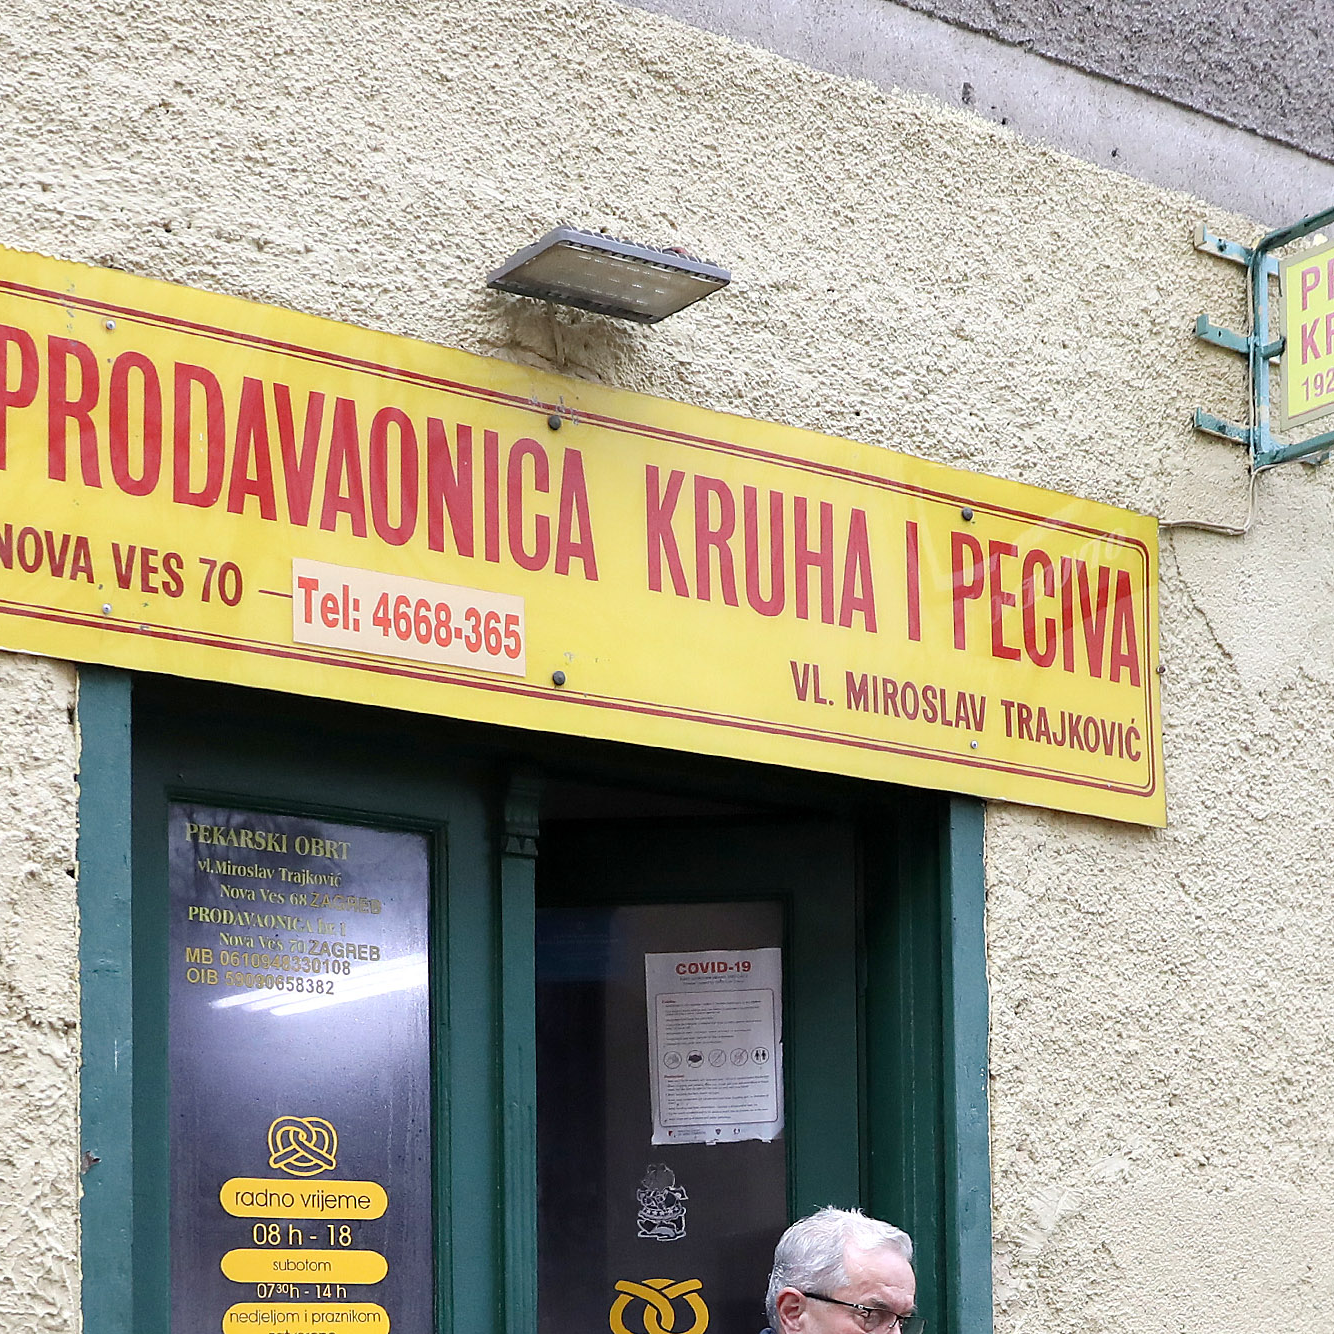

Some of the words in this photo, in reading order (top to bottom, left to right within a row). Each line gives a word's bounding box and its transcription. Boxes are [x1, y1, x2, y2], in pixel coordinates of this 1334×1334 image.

[110, 541, 186, 600] VES
[198, 556, 244, 608] 70
[644, 463, 879, 635] KRUHA
[905, 520, 922, 643] I
[950, 529, 1142, 689] PECIVA
[297, 575, 362, 634] Tel:
[371, 591, 523, 661] 4668-365
[789, 659, 835, 707] VL.
[845, 669, 988, 734] MIROSLAV
[1000, 698, 1143, 764] TRAJKOVIĆ
[184, 821, 288, 855] PEKARSKI
[294, 834, 352, 861] OBRT
[278, 867, 342, 888] Trajković
[219, 882, 255, 902] Nova
[259, 887, 285, 905] Ves
[289, 892, 307, 906] 68
[309, 892, 381, 914] ZAGREB
[187, 905, 313, 933] PRODAVAONICA
[185, 947, 213, 965] MB
[218, 931, 254, 949] Nova
[258, 935, 284, 952] Ves
[307, 939, 381, 961] ZAGREB
[185, 967, 218, 984] OIB
[675, 959, 752, 975] COVID-19
[234, 1188, 294, 1207] radno
[299, 1188, 371, 1211] vrijeme
[251, 1222, 281, 1245] 08
[287, 1223, 303, 1245] h
[326, 1223, 352, 1247] 18
[272, 1257, 332, 1272] subotom
[315, 1283, 332, 1298] 14
[335, 1283, 347, 1298] h
[229, 1308, 299, 1325] nedjeljom
[311, 1308, 381, 1326] praznikom
